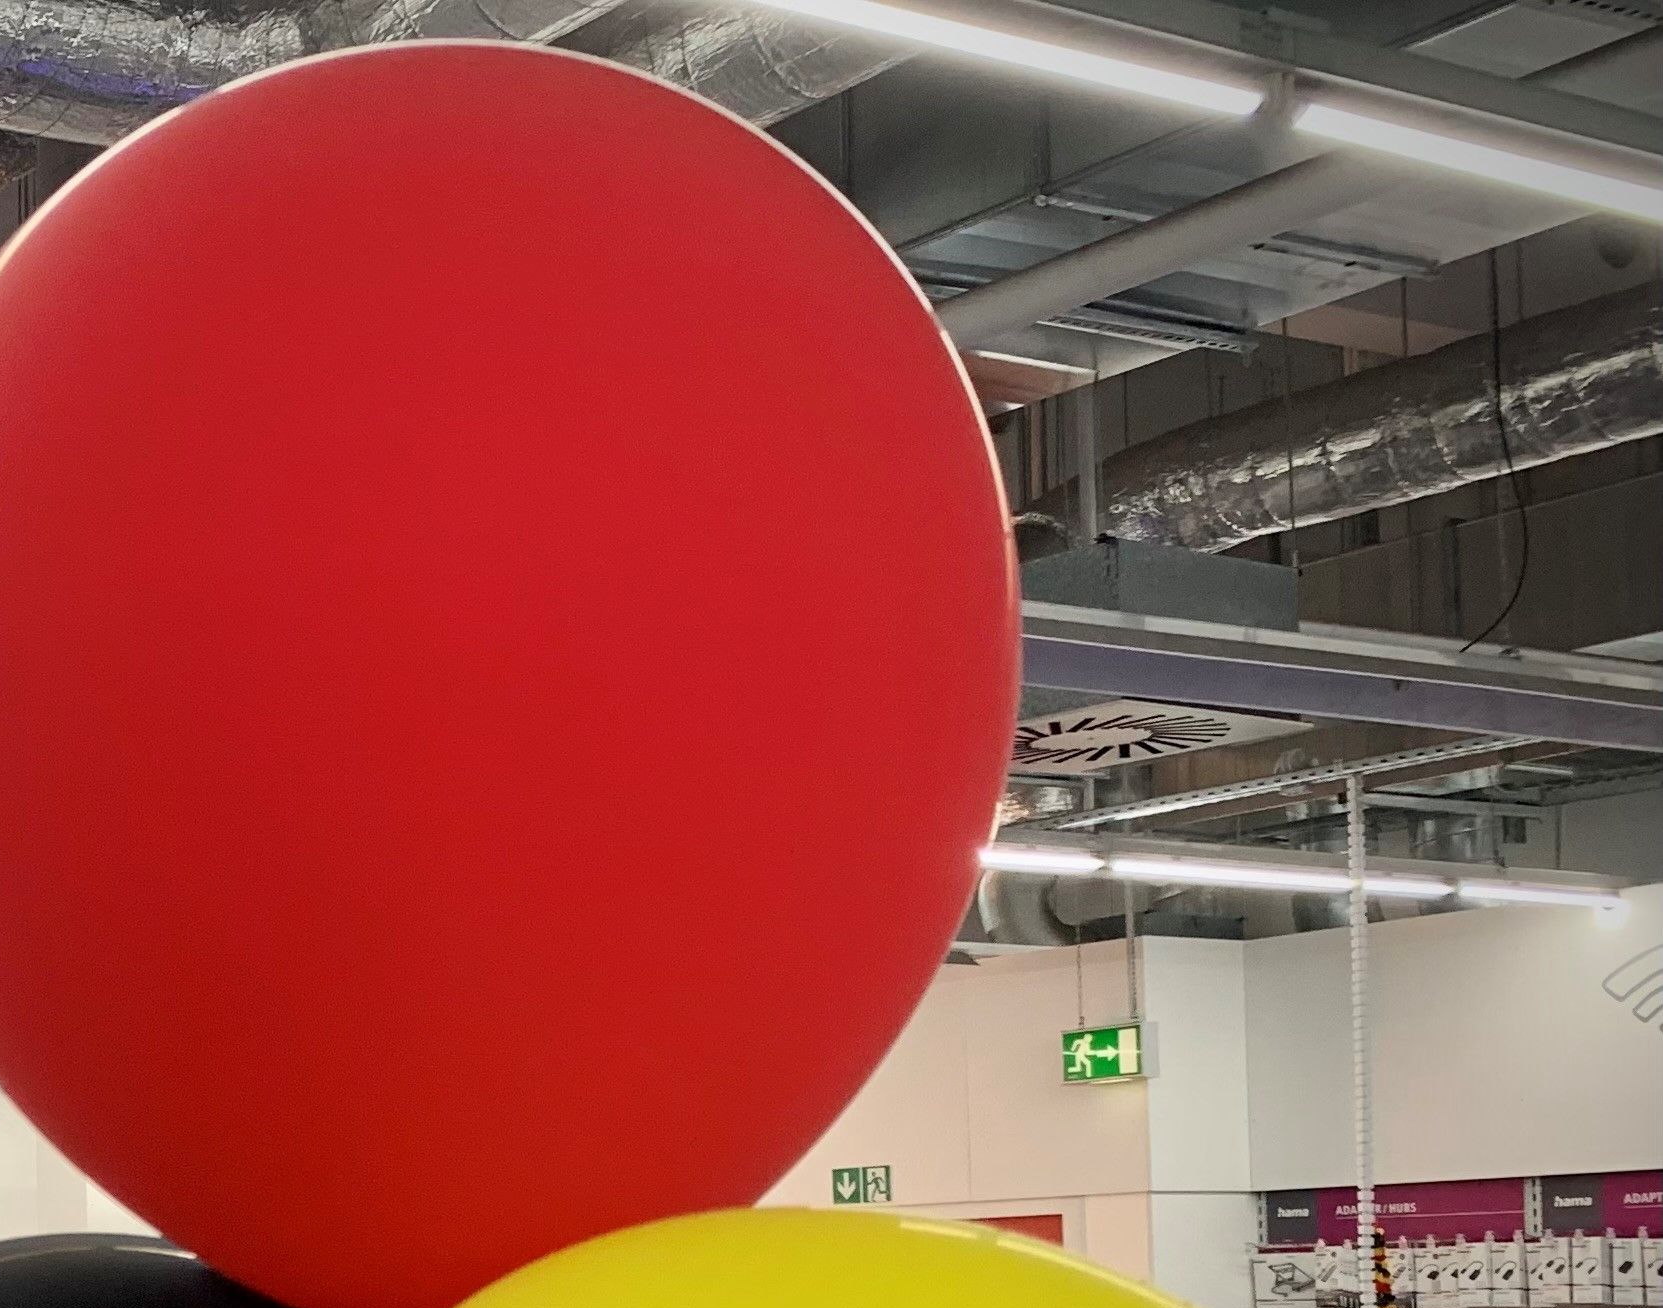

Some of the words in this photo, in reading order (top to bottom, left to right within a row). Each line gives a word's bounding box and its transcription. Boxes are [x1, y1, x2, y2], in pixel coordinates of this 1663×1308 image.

[1553, 1195, 1593, 1208] hama
[1277, 1206, 1310, 1218] hama
[1335, 1203, 1382, 1216] ADAR
[1389, 1201, 1417, 1214] HUBS
